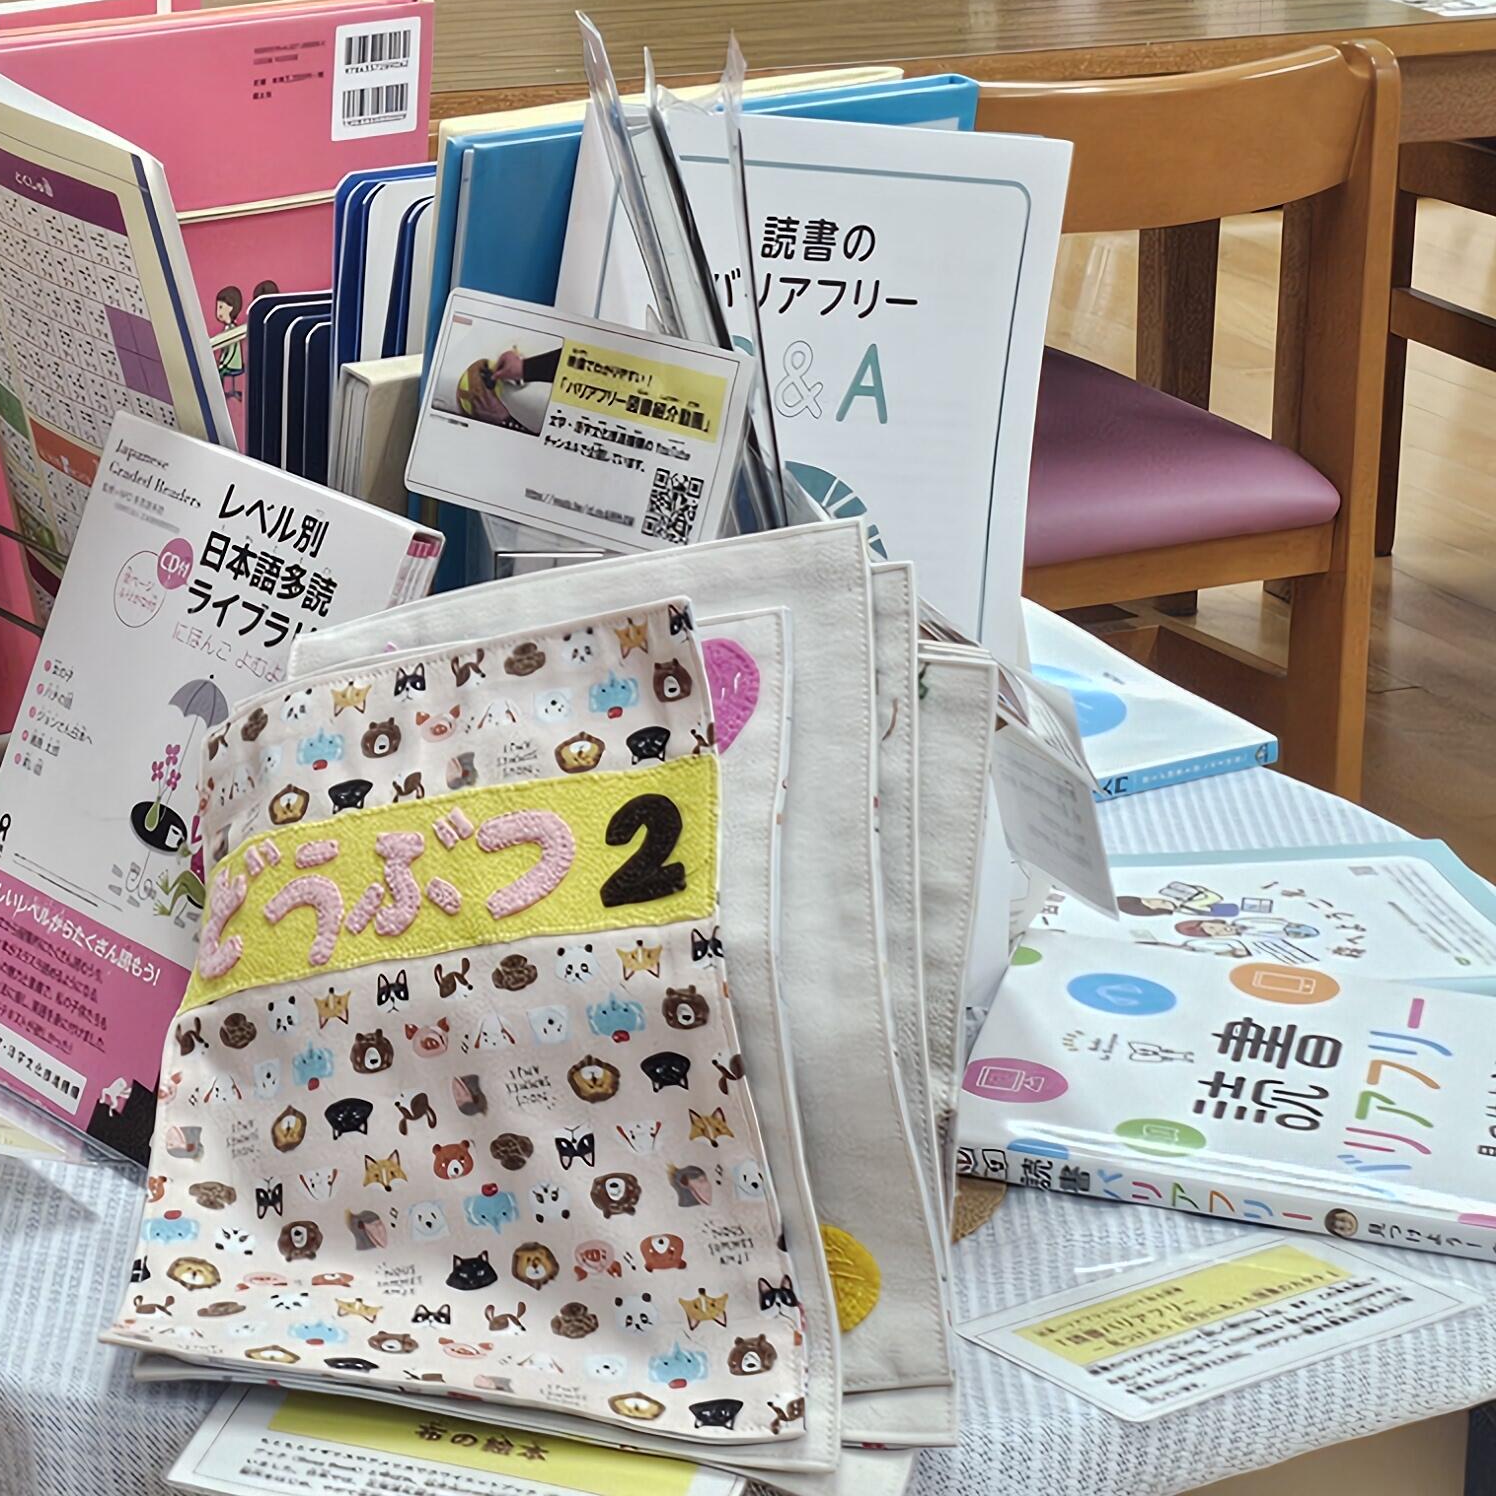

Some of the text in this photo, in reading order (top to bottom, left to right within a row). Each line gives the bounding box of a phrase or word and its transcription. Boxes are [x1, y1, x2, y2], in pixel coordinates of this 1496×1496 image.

[760, 215, 877, 262] 読書の
[835, 343, 889, 425] A
[109, 462, 202, 509] Graded Readers
[115, 439, 170, 469] Japanese
[218, 482, 329, 558] レベル別
[201, 530, 337, 616] 日本語多読
[200, 808, 577, 979] どうぶつ
[599, 793, 686, 907] 2
[1193, 1018, 1343, 1132] 読書
[1336, 998, 1454, 1197] バリアフリー
[414, 1421, 550, 1462] 布の絵本
